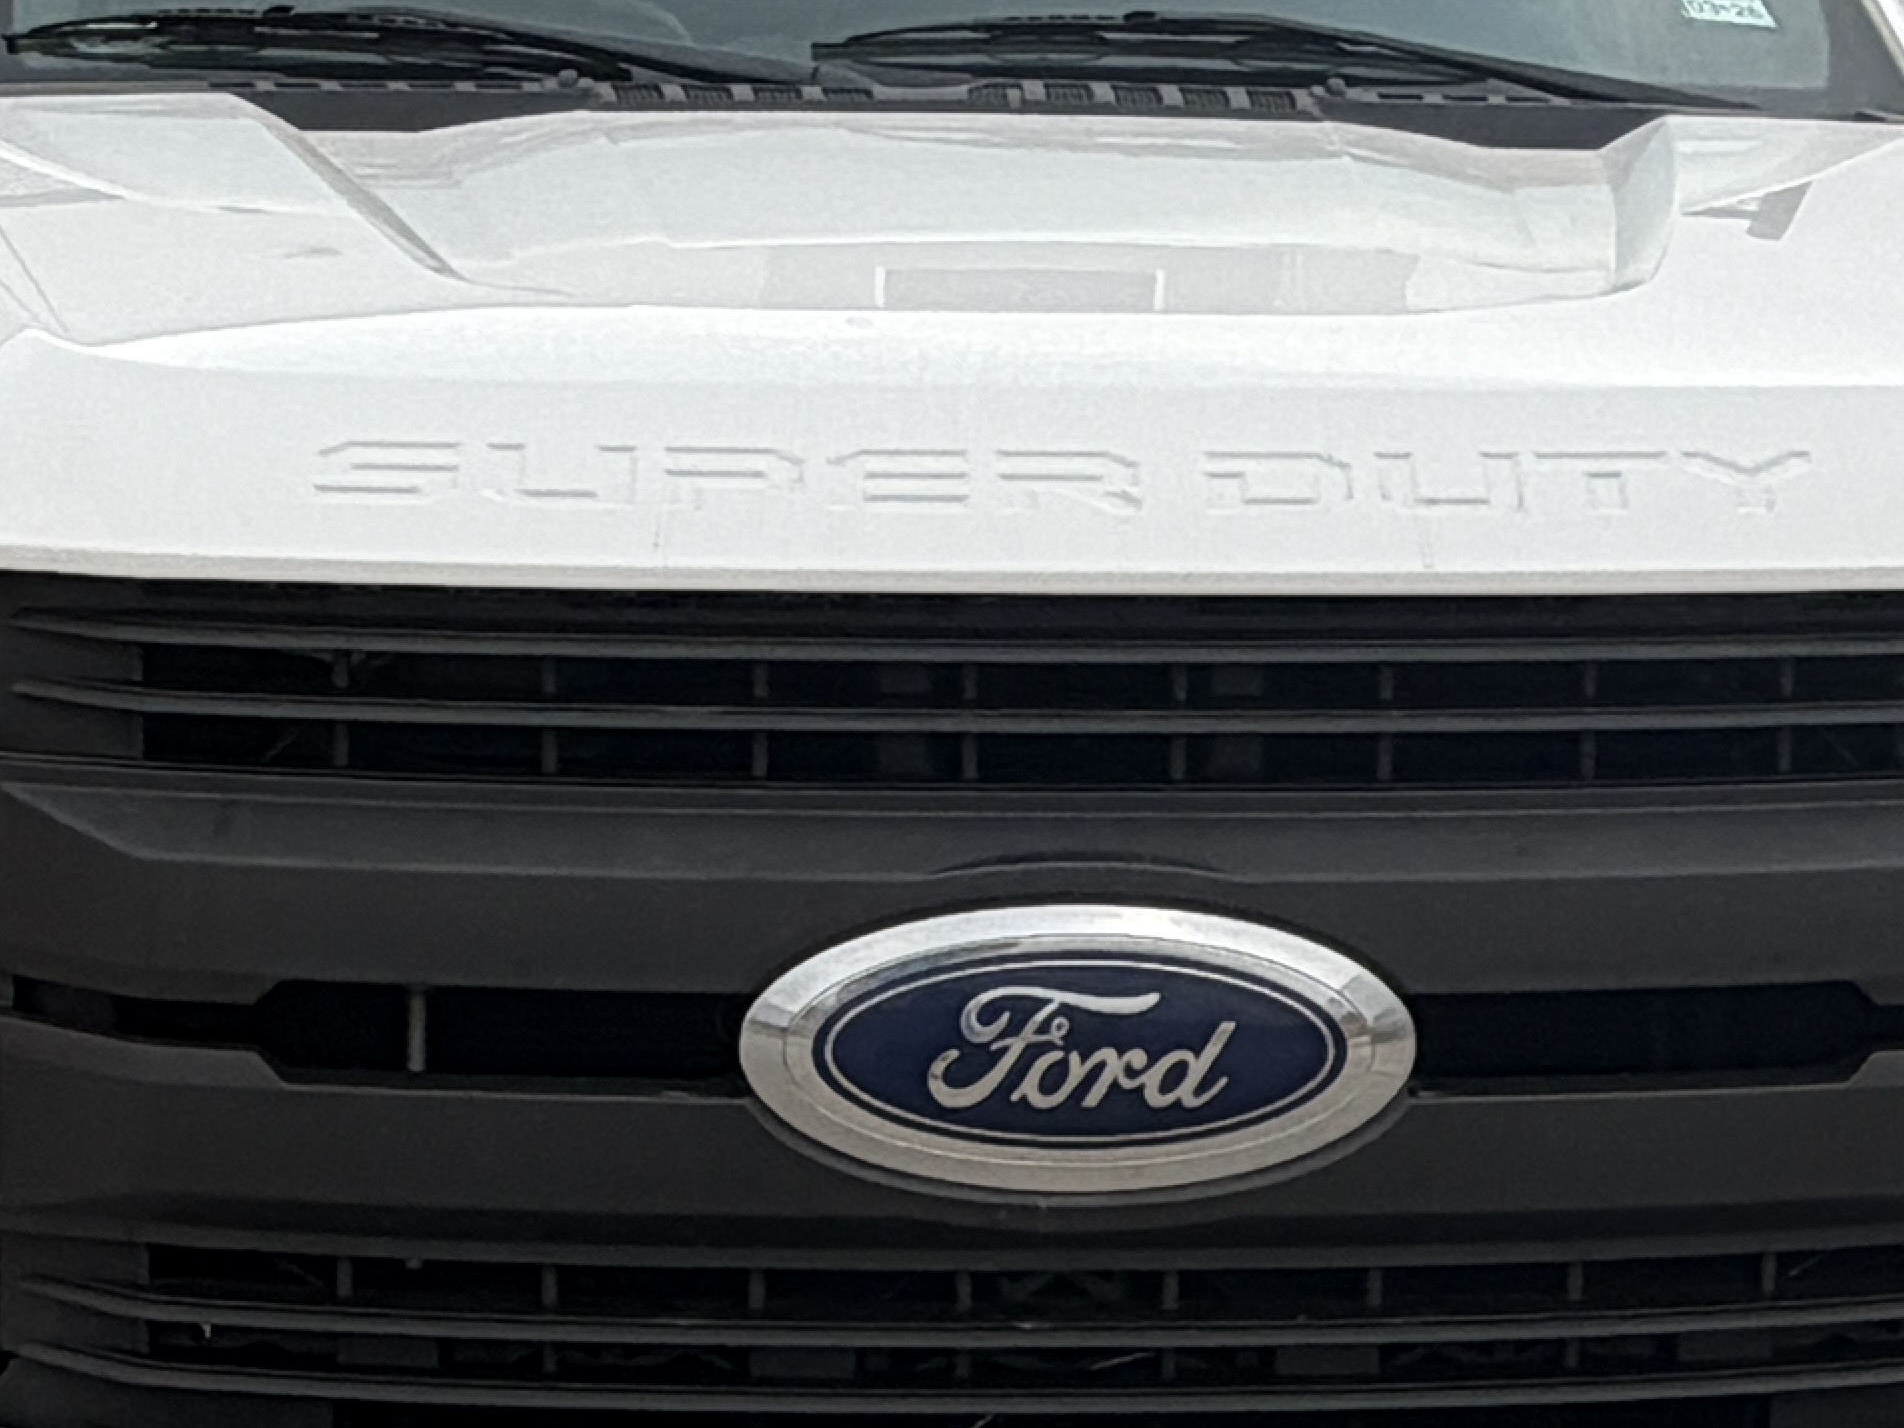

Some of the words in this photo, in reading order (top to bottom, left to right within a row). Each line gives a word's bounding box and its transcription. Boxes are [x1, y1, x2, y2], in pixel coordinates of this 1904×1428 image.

[311, 440, 1144, 515] SUPER
[1201, 449, 1813, 515] DUTY
[926, 983, 1237, 1111] Ford
